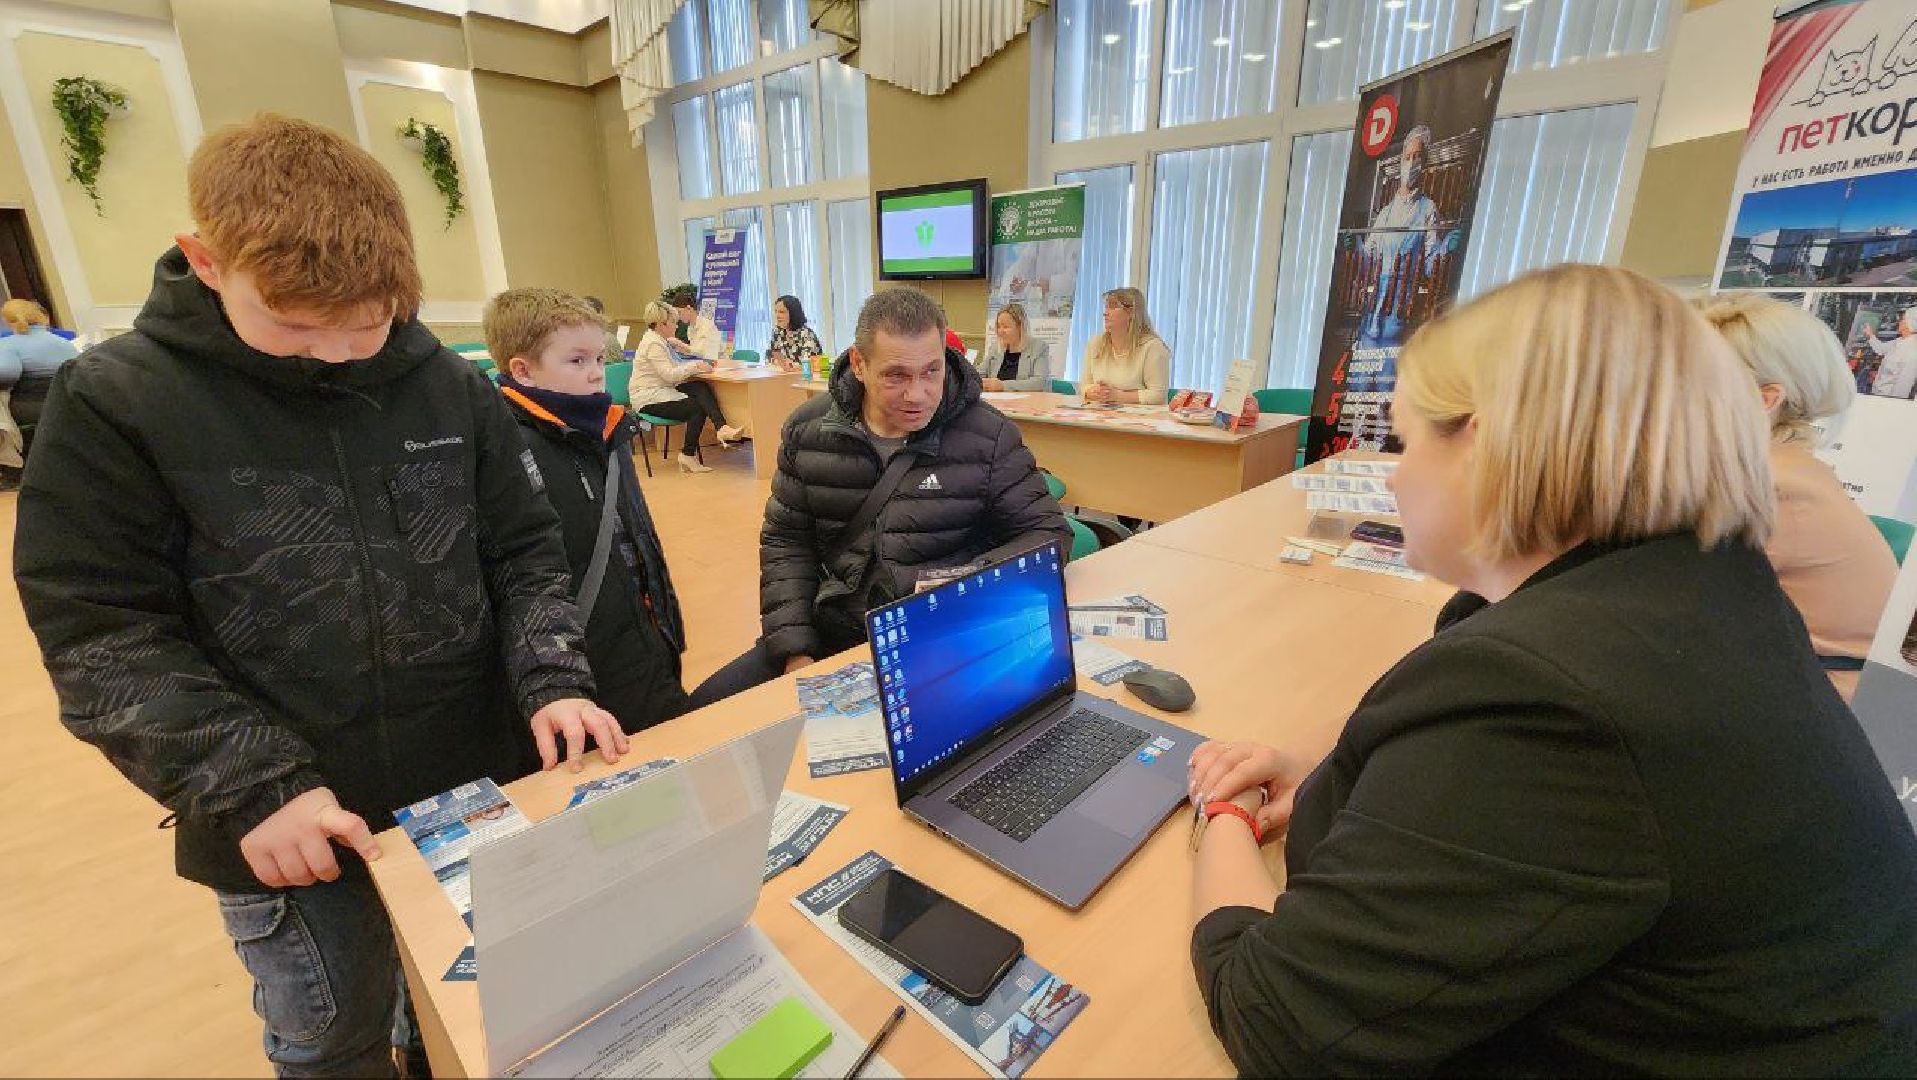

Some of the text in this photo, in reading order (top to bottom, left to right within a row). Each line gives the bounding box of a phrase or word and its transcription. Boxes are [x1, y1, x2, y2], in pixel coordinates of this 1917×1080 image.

[1761, 171, 1779, 184] НАС
[1781, 168, 1804, 181] ЕСТЬ
[1808, 160, 1849, 176] РАБОТА
[1852, 150, 1903, 169] ИМЕННО
